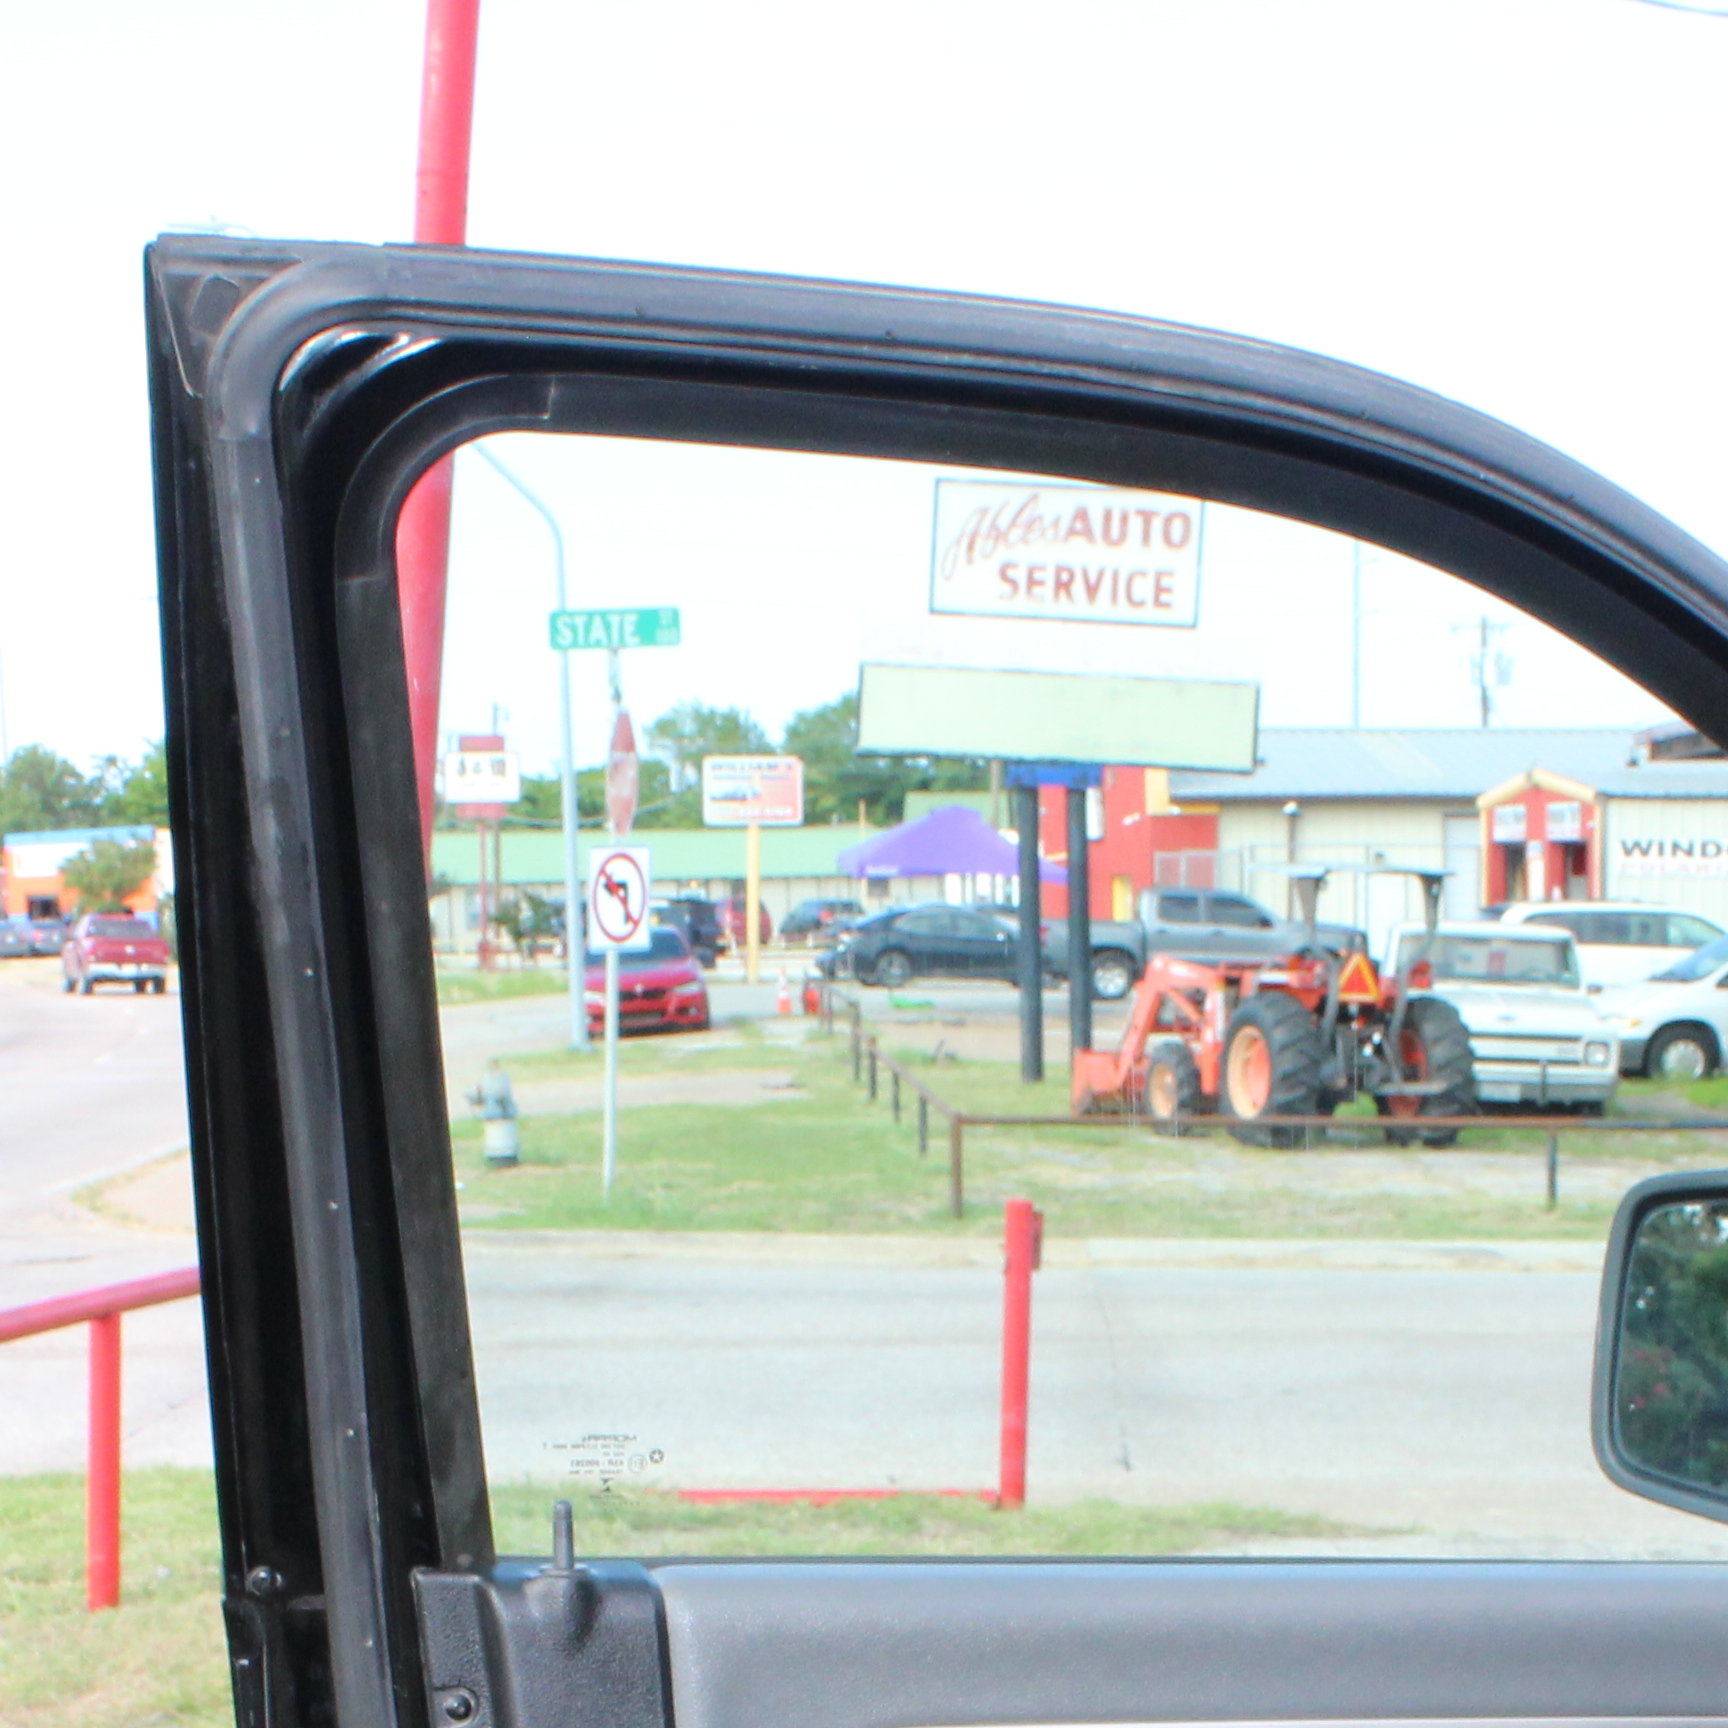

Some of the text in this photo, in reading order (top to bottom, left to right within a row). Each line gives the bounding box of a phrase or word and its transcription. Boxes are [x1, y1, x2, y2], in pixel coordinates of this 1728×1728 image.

[1064, 506, 1193, 551] AUTO
[998, 561, 1175, 610] SERVICE
[555, 613, 641, 648] STATE
